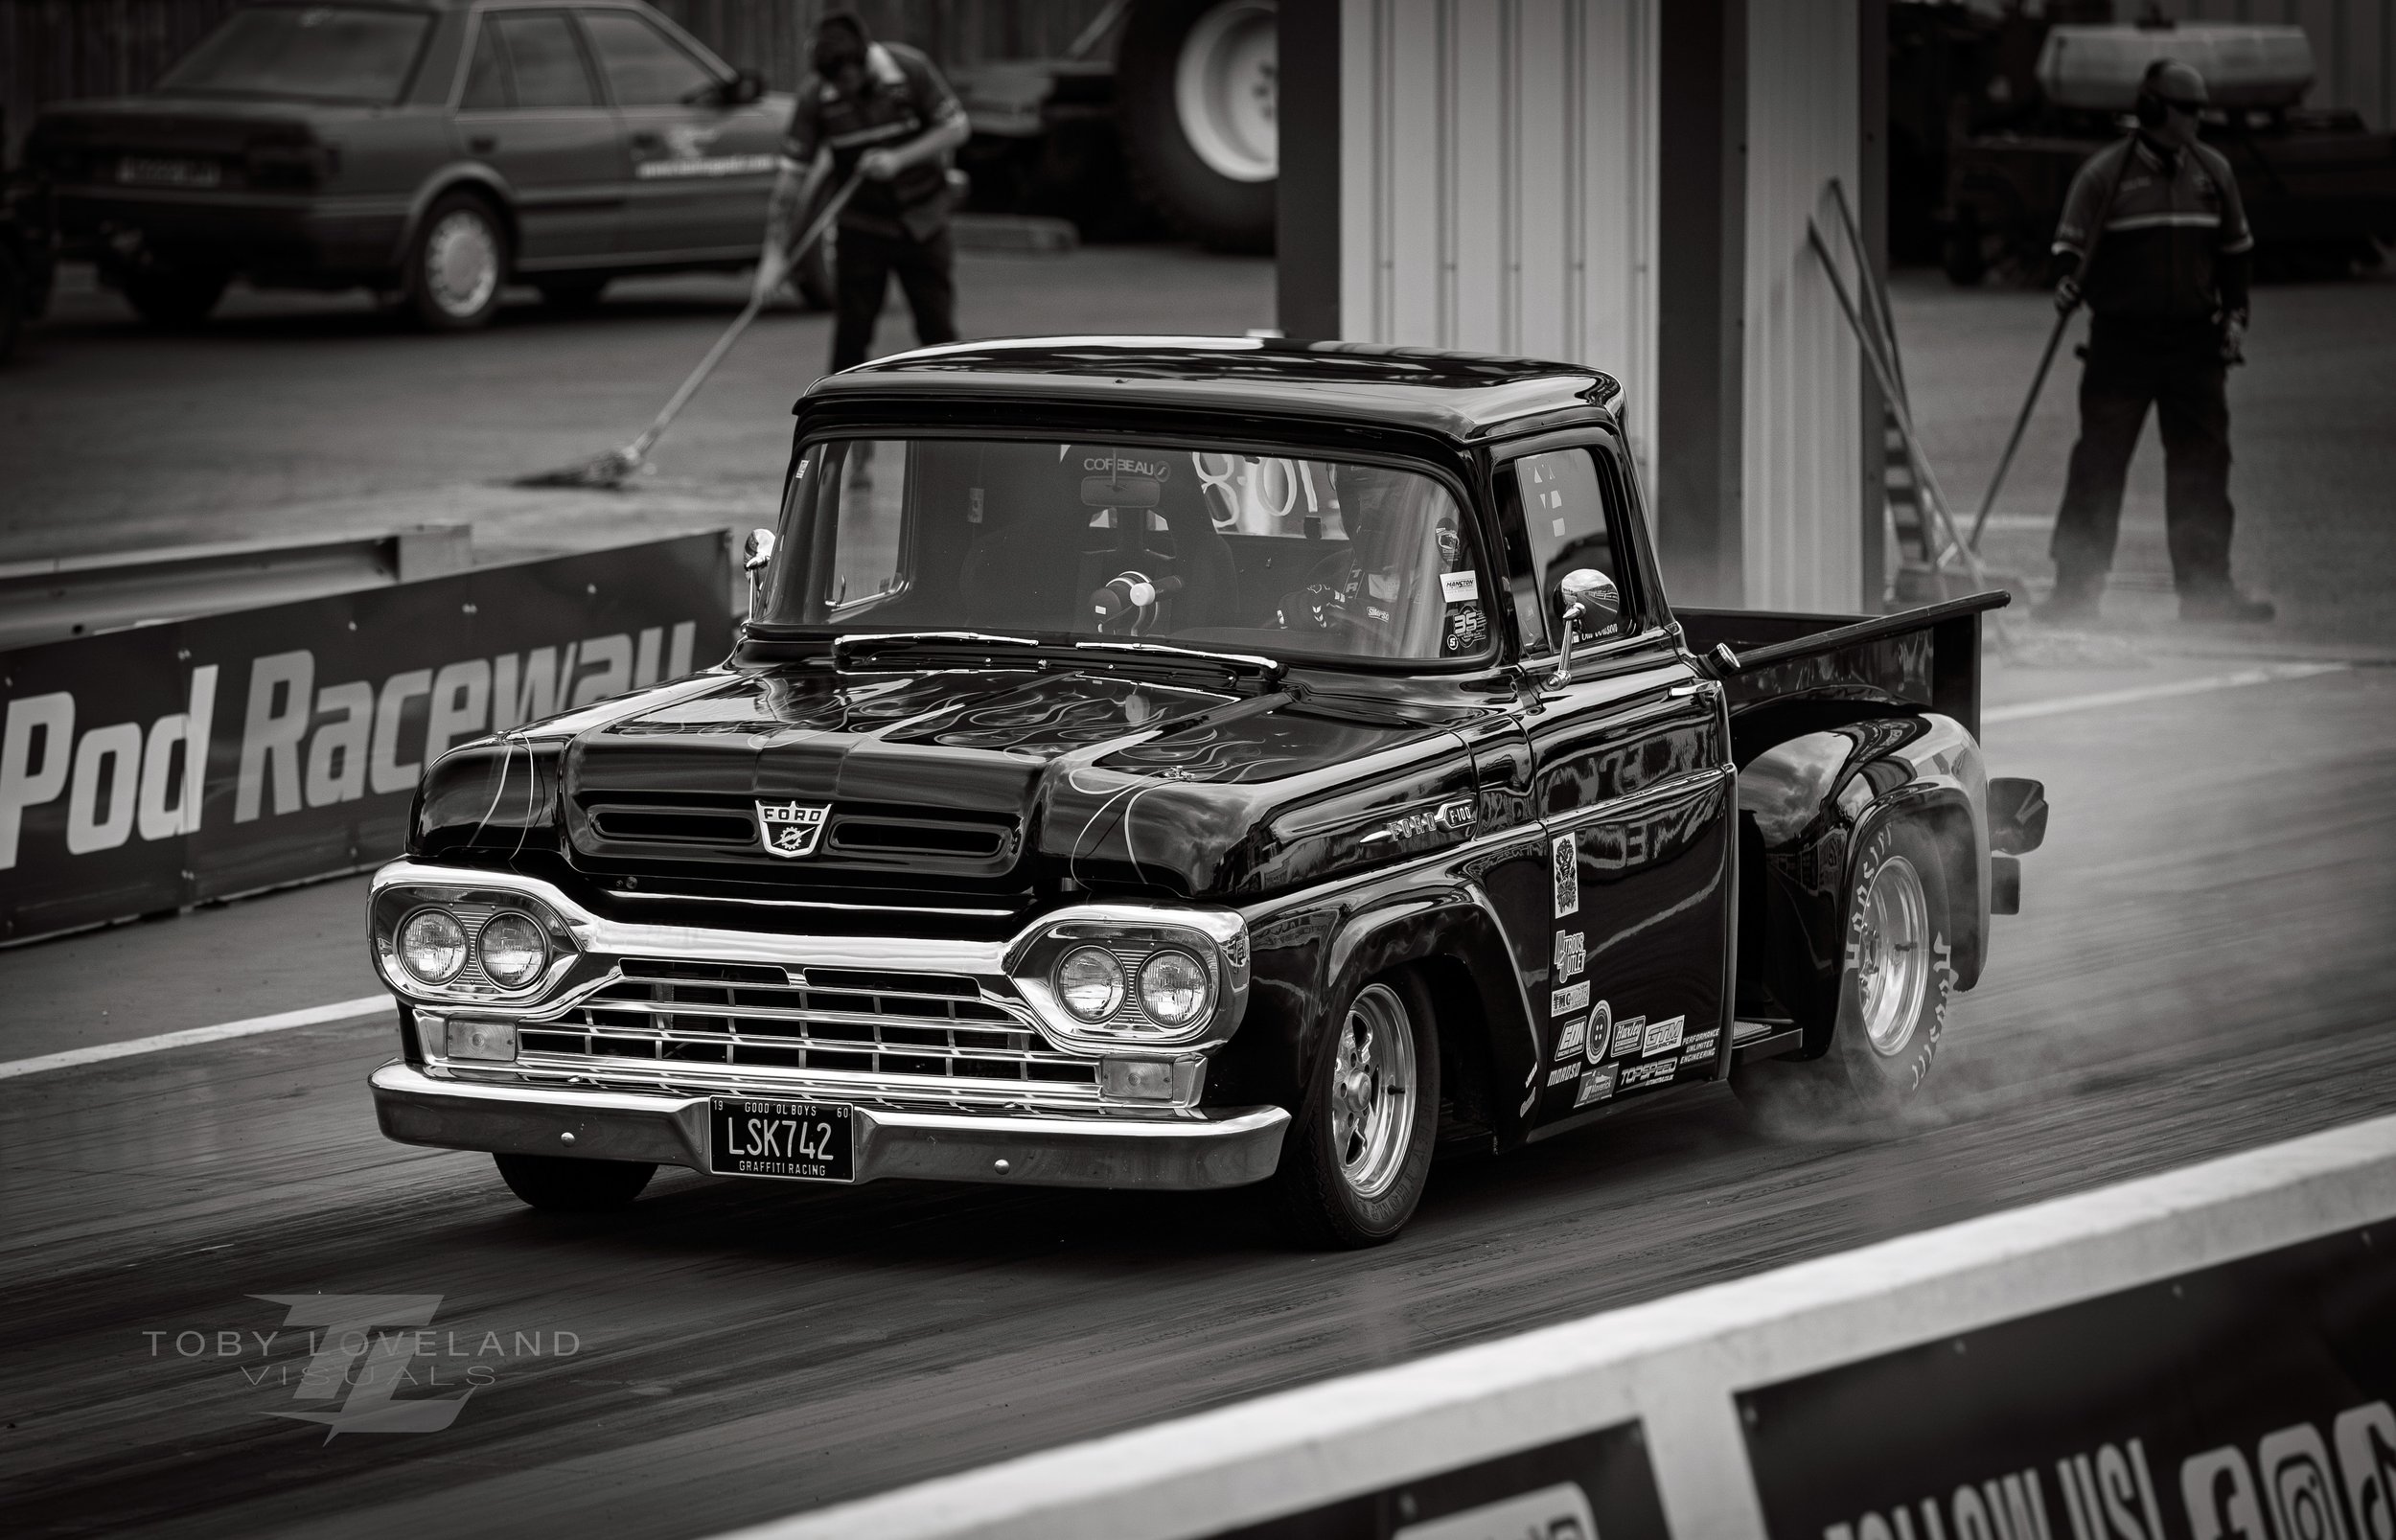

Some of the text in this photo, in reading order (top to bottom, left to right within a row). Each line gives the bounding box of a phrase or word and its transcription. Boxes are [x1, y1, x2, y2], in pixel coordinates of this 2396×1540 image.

[1368, 607, 1390, 622] SIMPSO
[0, 664, 219, 869] Pod
[764, 808, 821, 821] FORD
[1387, 812, 1437, 841] FORD
[1646, 1020, 1683, 1046] GTM
[1682, 1028, 1719, 1046] PERFORMANCE
[1686, 1039, 1714, 1053] UNLIMITED
[1680, 1048, 1716, 1065] ENGINEERING
[1621, 1057, 1677, 1085] TOPSPEED
[713, 1101, 724, 1111] 19
[745, 1102, 770, 1114] GOOD
[791, 1105, 817, 1116] BOYS
[837, 1108, 848, 1118] 60
[727, 1116, 834, 1161] LSK742
[739, 1161, 826, 1177] GRAFFITI RACING
